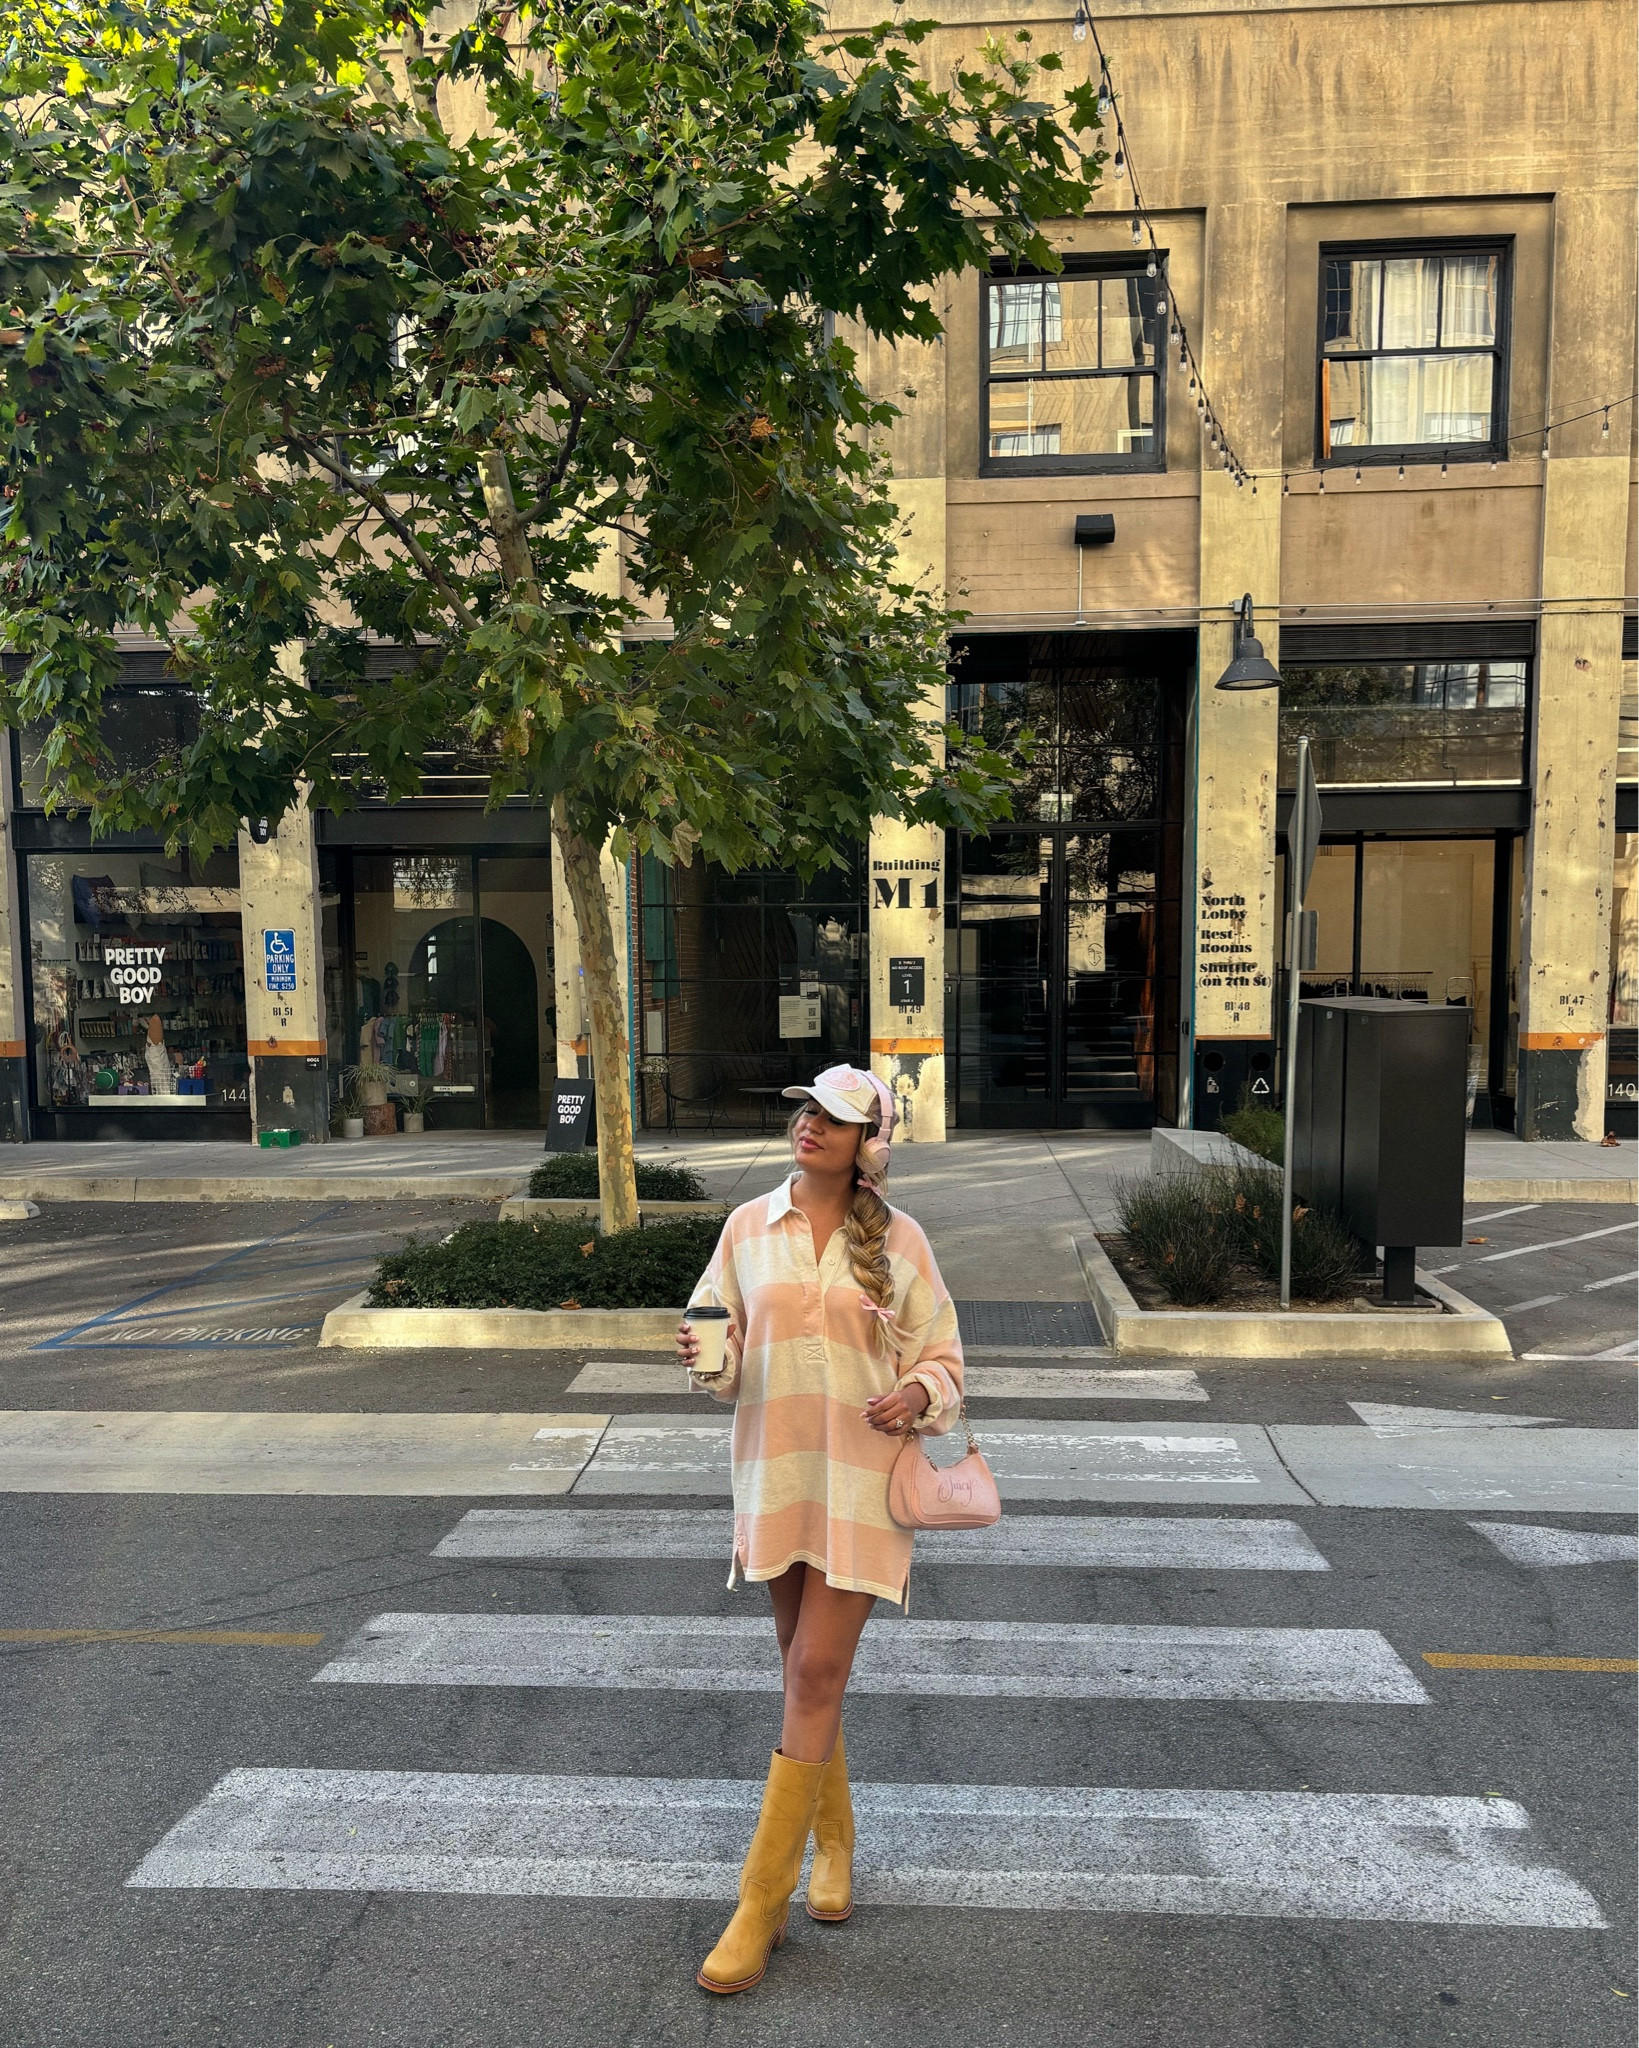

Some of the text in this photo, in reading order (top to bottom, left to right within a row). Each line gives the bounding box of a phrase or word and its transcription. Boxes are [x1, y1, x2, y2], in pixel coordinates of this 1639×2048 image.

[873, 859, 941, 872] Building
[1202, 895, 1246, 906] North
[1201, 909, 1248, 921] Lobby
[1200, 943, 1252, 953] Rooms
[105, 947, 166, 965] PRETTY
[266, 954, 294, 963] PARKING
[272, 964, 289, 973] ONLY
[1199, 962, 1257, 973] Shuttle
[110, 967, 162, 984] GOOD
[903, 979, 910, 994] 1
[1198, 976, 1272, 988] (on 7th St)
[120, 986, 154, 1004] BOY
[1572, 995, 1585, 1005] 47
[1237, 1001, 1251, 1010] 48
[222, 1088, 247, 1102] 144
[1608, 1083, 1636, 1097] 140
[556, 1094, 586, 1104] PRETTY
[557, 1105, 582, 1115] GOOD
[559, 1115, 577, 1124] BOY
[101, 1327, 305, 1341] NO PARKING
